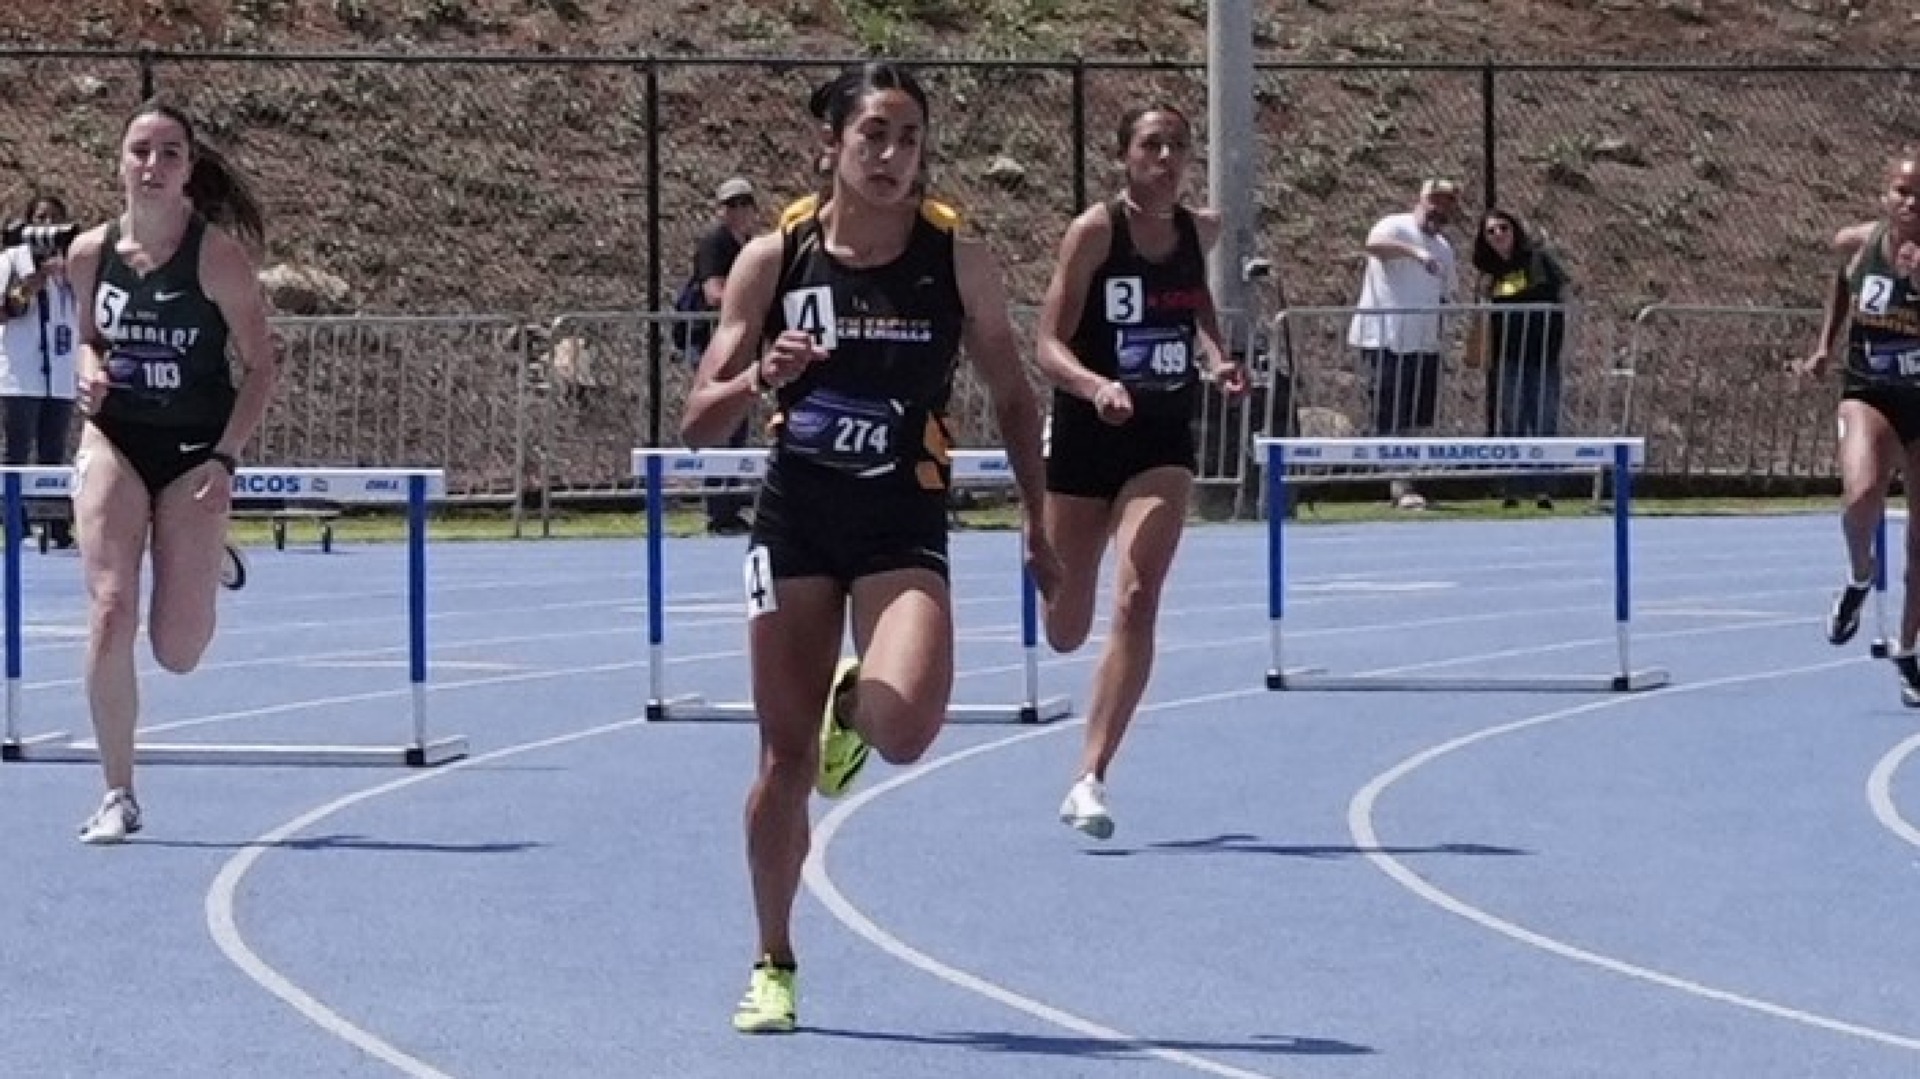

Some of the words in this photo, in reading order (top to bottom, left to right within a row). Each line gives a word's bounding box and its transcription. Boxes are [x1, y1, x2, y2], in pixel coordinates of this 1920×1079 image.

[101, 290, 121, 328] 5
[1114, 281, 1134, 321] 3
[1865, 280, 1885, 312] 2
[797, 293, 826, 345] 4
[142, 362, 181, 388] 103
[1150, 341, 1186, 374] 499
[833, 416, 889, 454] 274
[1377, 445, 1420, 459] SAN
[1428, 445, 1520, 459] MARCOS
[232, 475, 301, 492] RCOS
[750, 556, 767, 608] 4
